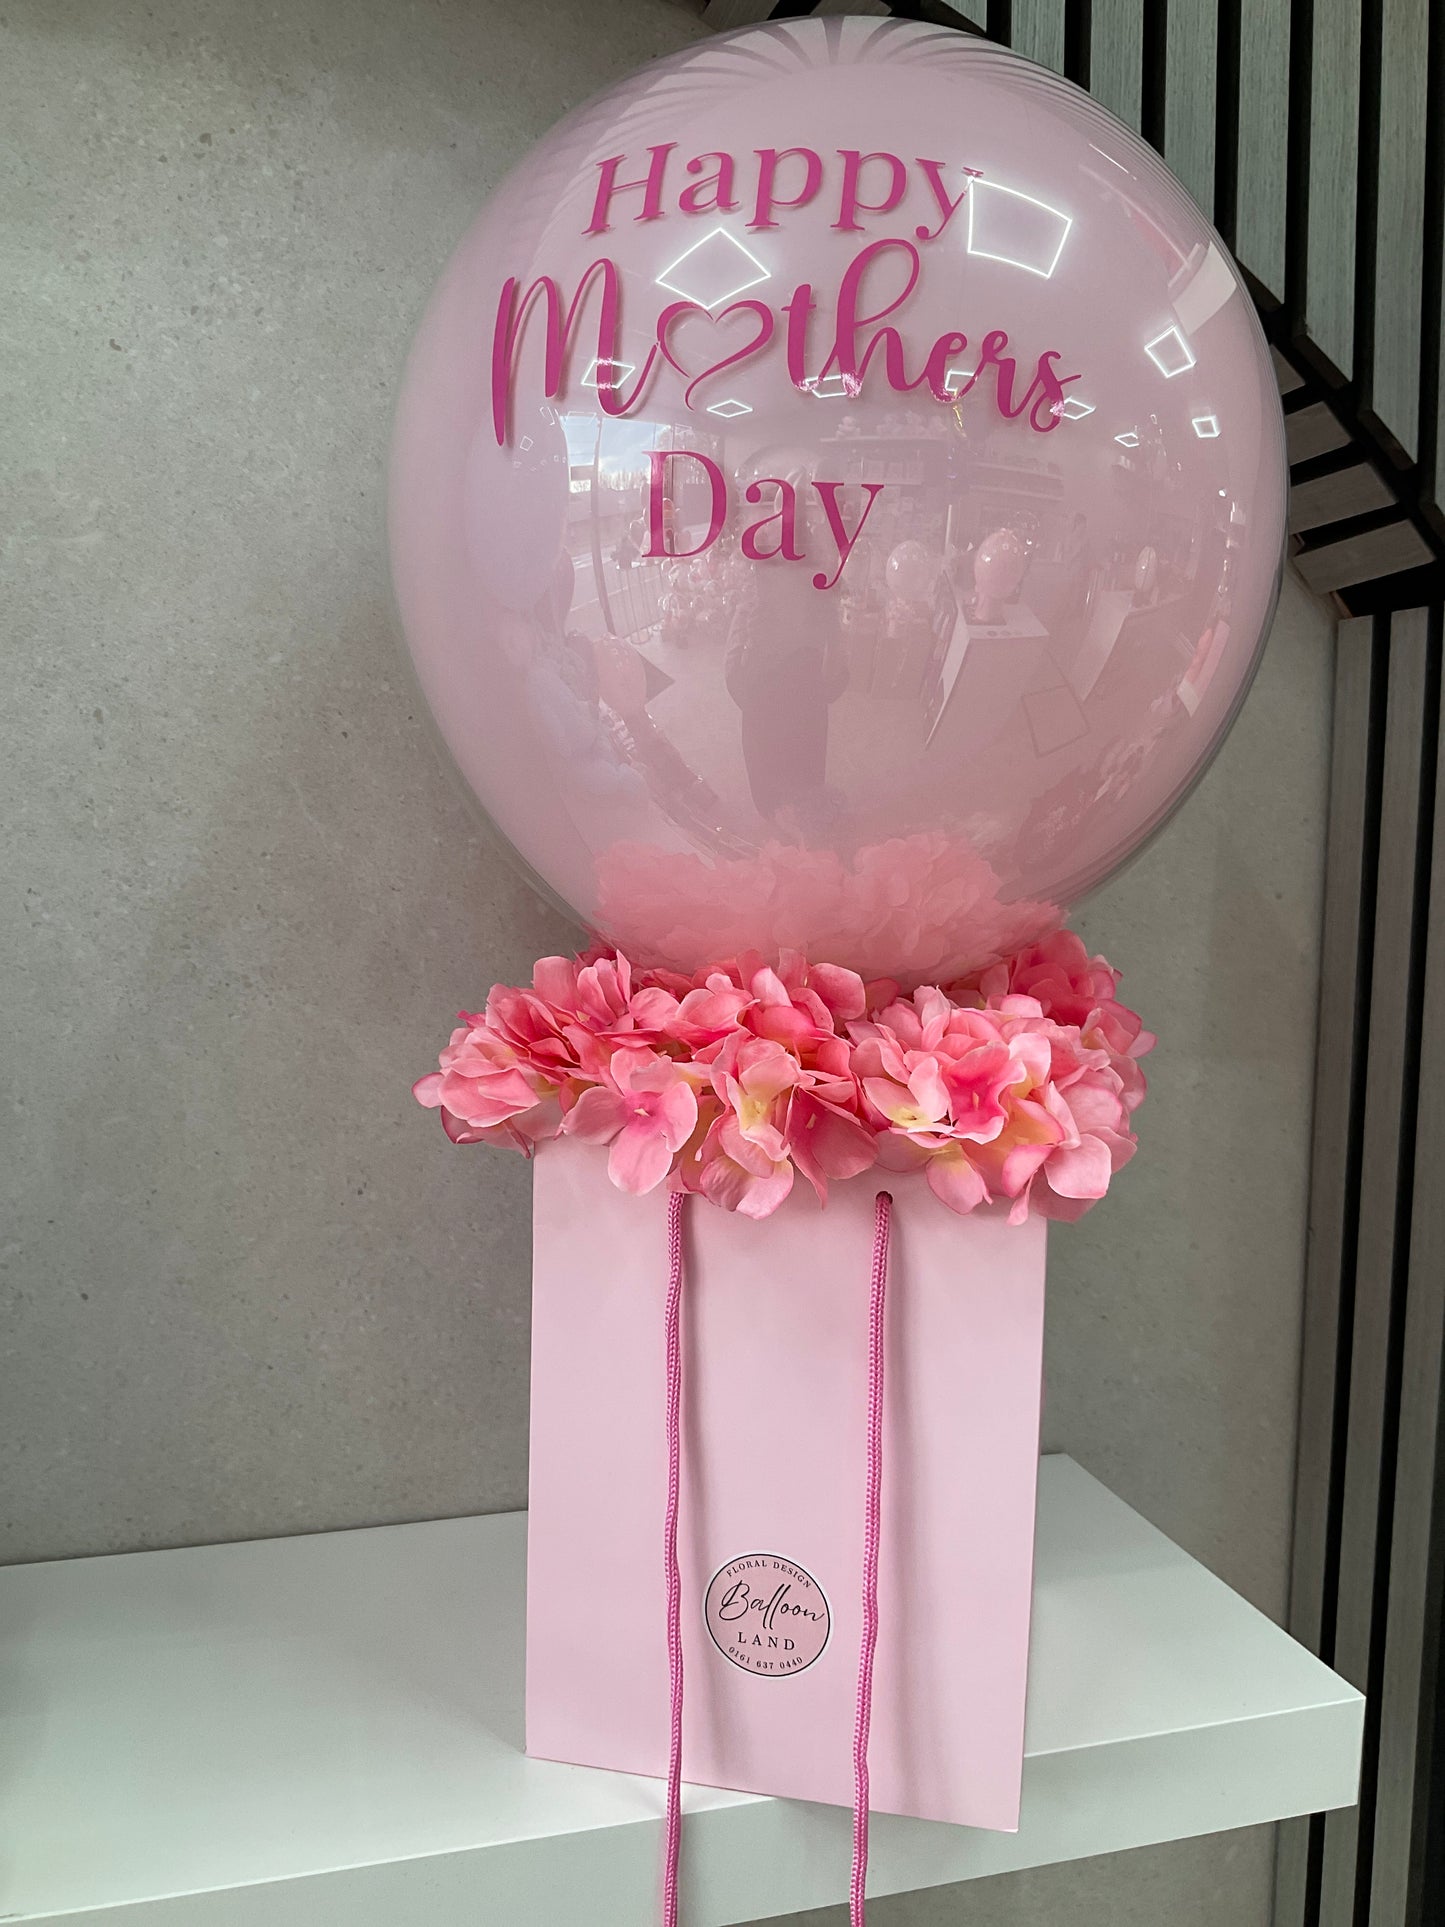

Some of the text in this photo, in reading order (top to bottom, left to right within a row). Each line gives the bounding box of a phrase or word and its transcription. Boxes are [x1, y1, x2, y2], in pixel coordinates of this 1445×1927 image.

[581, 141, 983, 240] Happy
[641, 450, 885, 590] Day
[726, 1559, 812, 1588] FLORAL DESIGN
[718, 1579, 825, 1630] Balloon
[728, 1646, 803, 1670] 0161 637 0440
[737, 1631, 796, 1651] LAND
